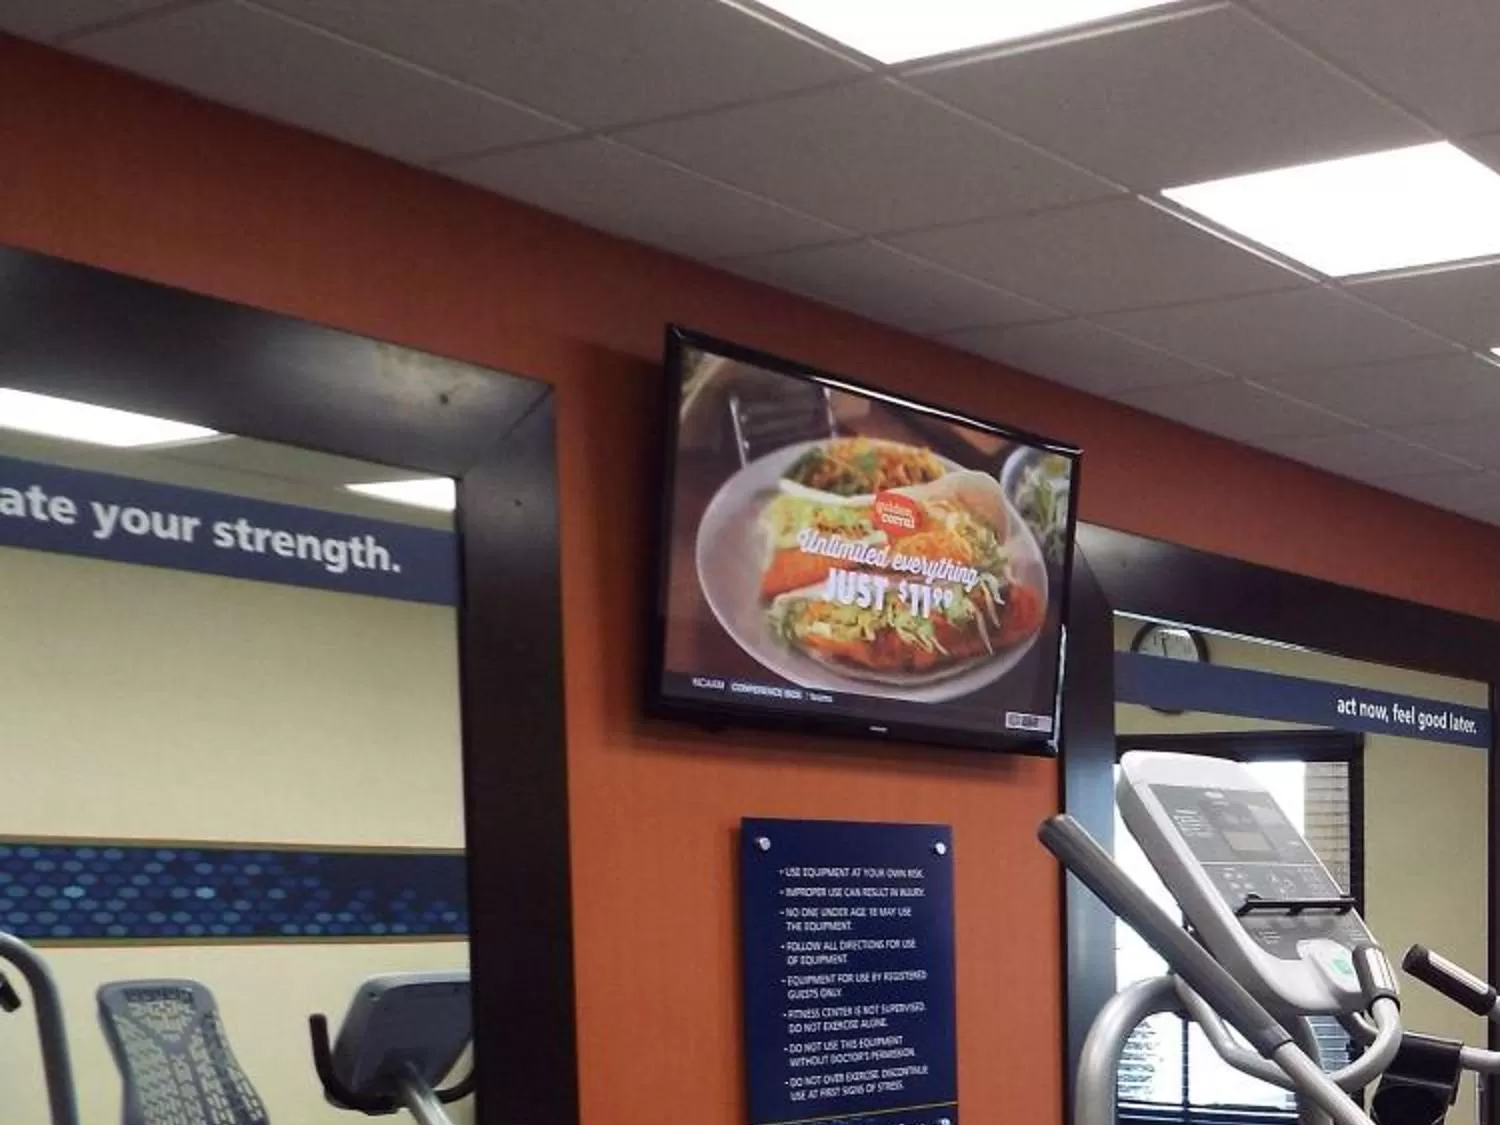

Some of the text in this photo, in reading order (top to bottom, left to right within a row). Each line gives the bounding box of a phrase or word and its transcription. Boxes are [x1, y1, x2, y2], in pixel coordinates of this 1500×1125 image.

[91, 501, 201, 541] your
[212, 517, 402, 574] strength.
[797, 529, 980, 592] Unlimited everything
[824, 568, 889, 611] JUST
[1336, 697, 1477, 734] act now, feel good later.
[785, 867, 800, 877] USE
[802, 867, 849, 878] EQUIPMENT
[851, 867, 861, 877] AT
[863, 867, 885, 878] YOUR
[785, 887, 826, 897] IMPROPER
[828, 887, 842, 897] USE
[785, 907, 799, 917] NO
[801, 907, 818, 917] ONE
[821, 907, 849, 917] UNDER
[850, 907, 866, 917] AGE
[897, 907, 912, 917] USE
[785, 921, 802, 931] THE
[786, 941, 821, 951] FOLLOW
[823, 941, 838, 951] ALL
[839, 939, 884, 950] DIRECTIONS
[885, 939, 901, 949] FOR
[787, 956, 799, 966] OF
[787, 974, 836, 986] EQUIPMENT
[837, 973, 854, 983] FOR
[855, 972, 869, 982] USE
[871, 972, 882, 982] BY
[788, 1007, 820, 1018] FITNESS
[821, 1006, 853, 1017] CENTER
[863, 1004, 880, 1015] NOT
[788, 1023, 803, 1033] DO
[804, 1021, 822, 1032] NOT
[823, 1020, 859, 1031] EXERCISE
[789, 1035, 903, 1053] DO NOT USE THIS EQUIPMENT
[789, 1055, 829, 1067] WITHOUT
[789, 1077, 803, 1088] DO
[804, 1075, 822, 1086] NOT
[823, 1073, 845, 1085] OVER
[790, 1089, 806, 1101] USE
[807, 1088, 819, 1099] AT
[866, 1083, 876, 1093] OF
